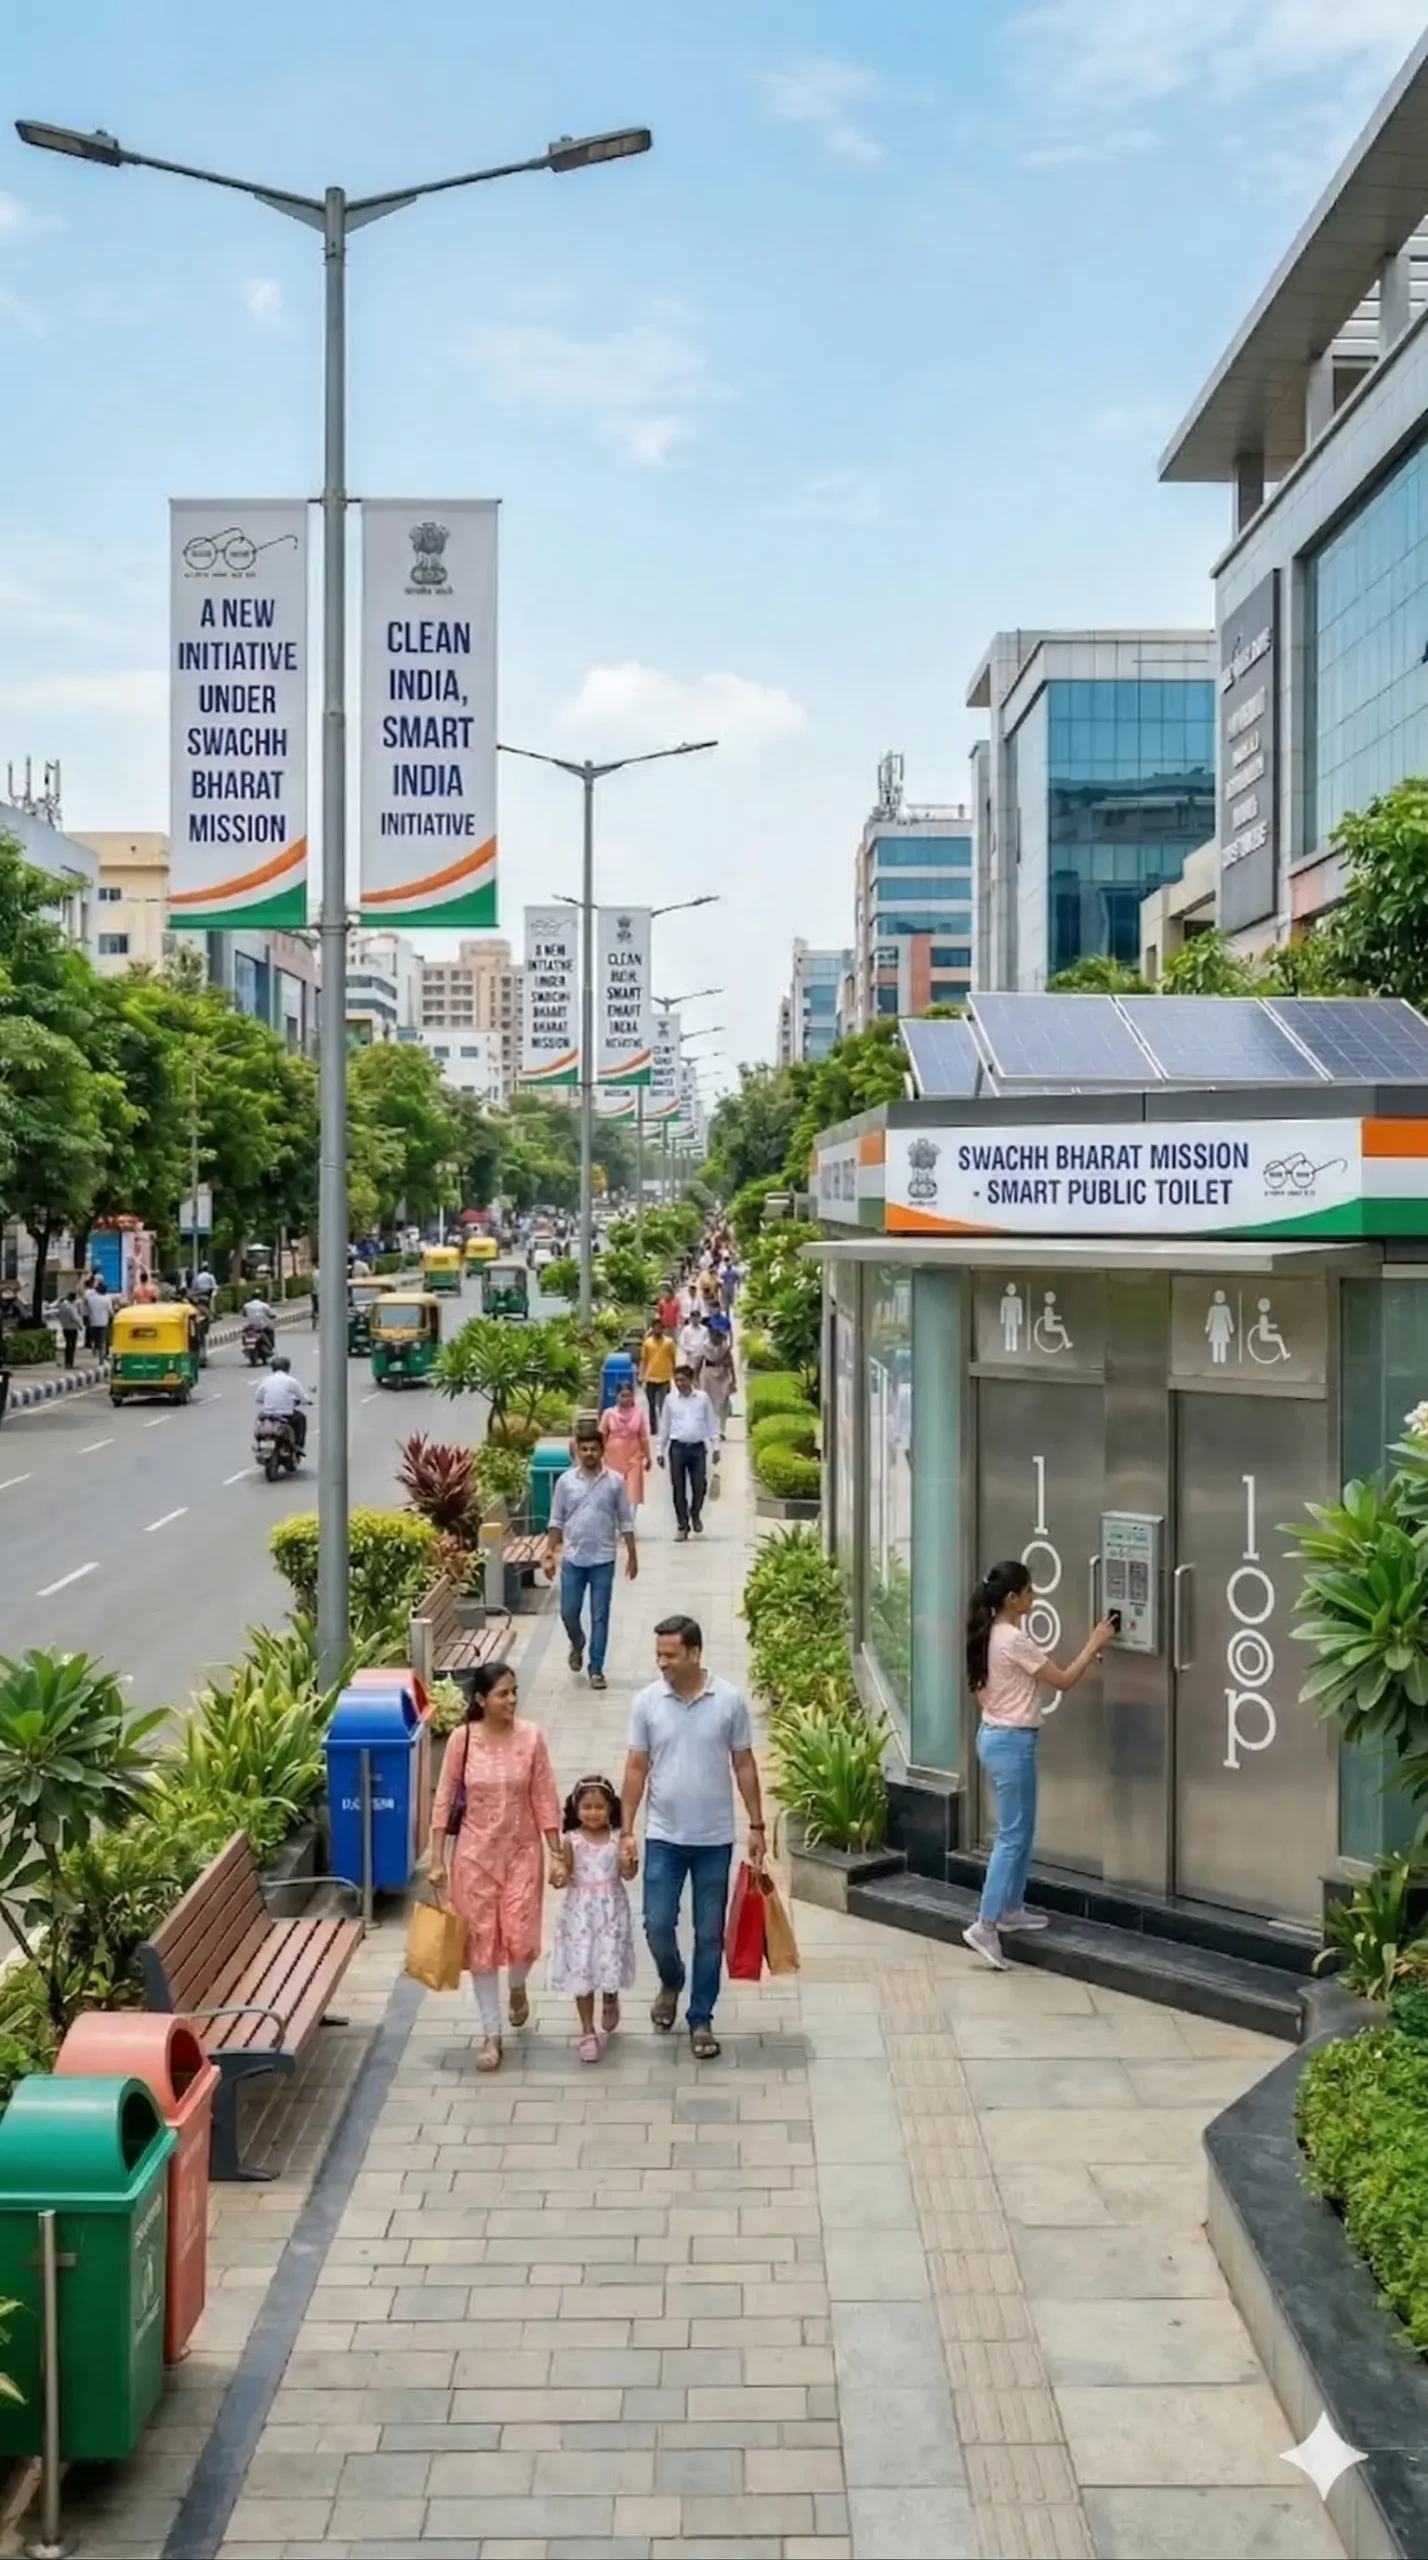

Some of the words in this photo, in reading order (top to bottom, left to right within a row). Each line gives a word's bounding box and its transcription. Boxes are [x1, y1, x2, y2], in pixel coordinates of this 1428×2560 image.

[200, 598, 216, 628] A
[222, 598, 275, 628] NEW
[387, 621, 471, 654] CLEAN
[178, 642, 298, 671] INITIATIVE
[198, 684, 276, 714] UNDER
[389, 669, 469, 707] INDIA,
[187, 727, 288, 757] SWACHH
[382, 715, 475, 749] SMART
[191, 770, 284, 800] BHARAT
[393, 764, 464, 797] INDIA
[188, 814, 286, 843] MISSION
[380, 812, 476, 837] INITIATIVE
[958, 1144, 1049, 1172] SWACHH
[1056, 1143, 1143, 1171] BHARAT
[1150, 1141, 1250, 1170] MISSION
[986, 1179, 1062, 1206] SMART
[1067, 1179, 1148, 1206] PUBLIC
[1154, 1177, 1234, 1206] TOILET
[1020, 1455, 1063, 1715] loo
[1222, 1474, 1277, 1770] loop
